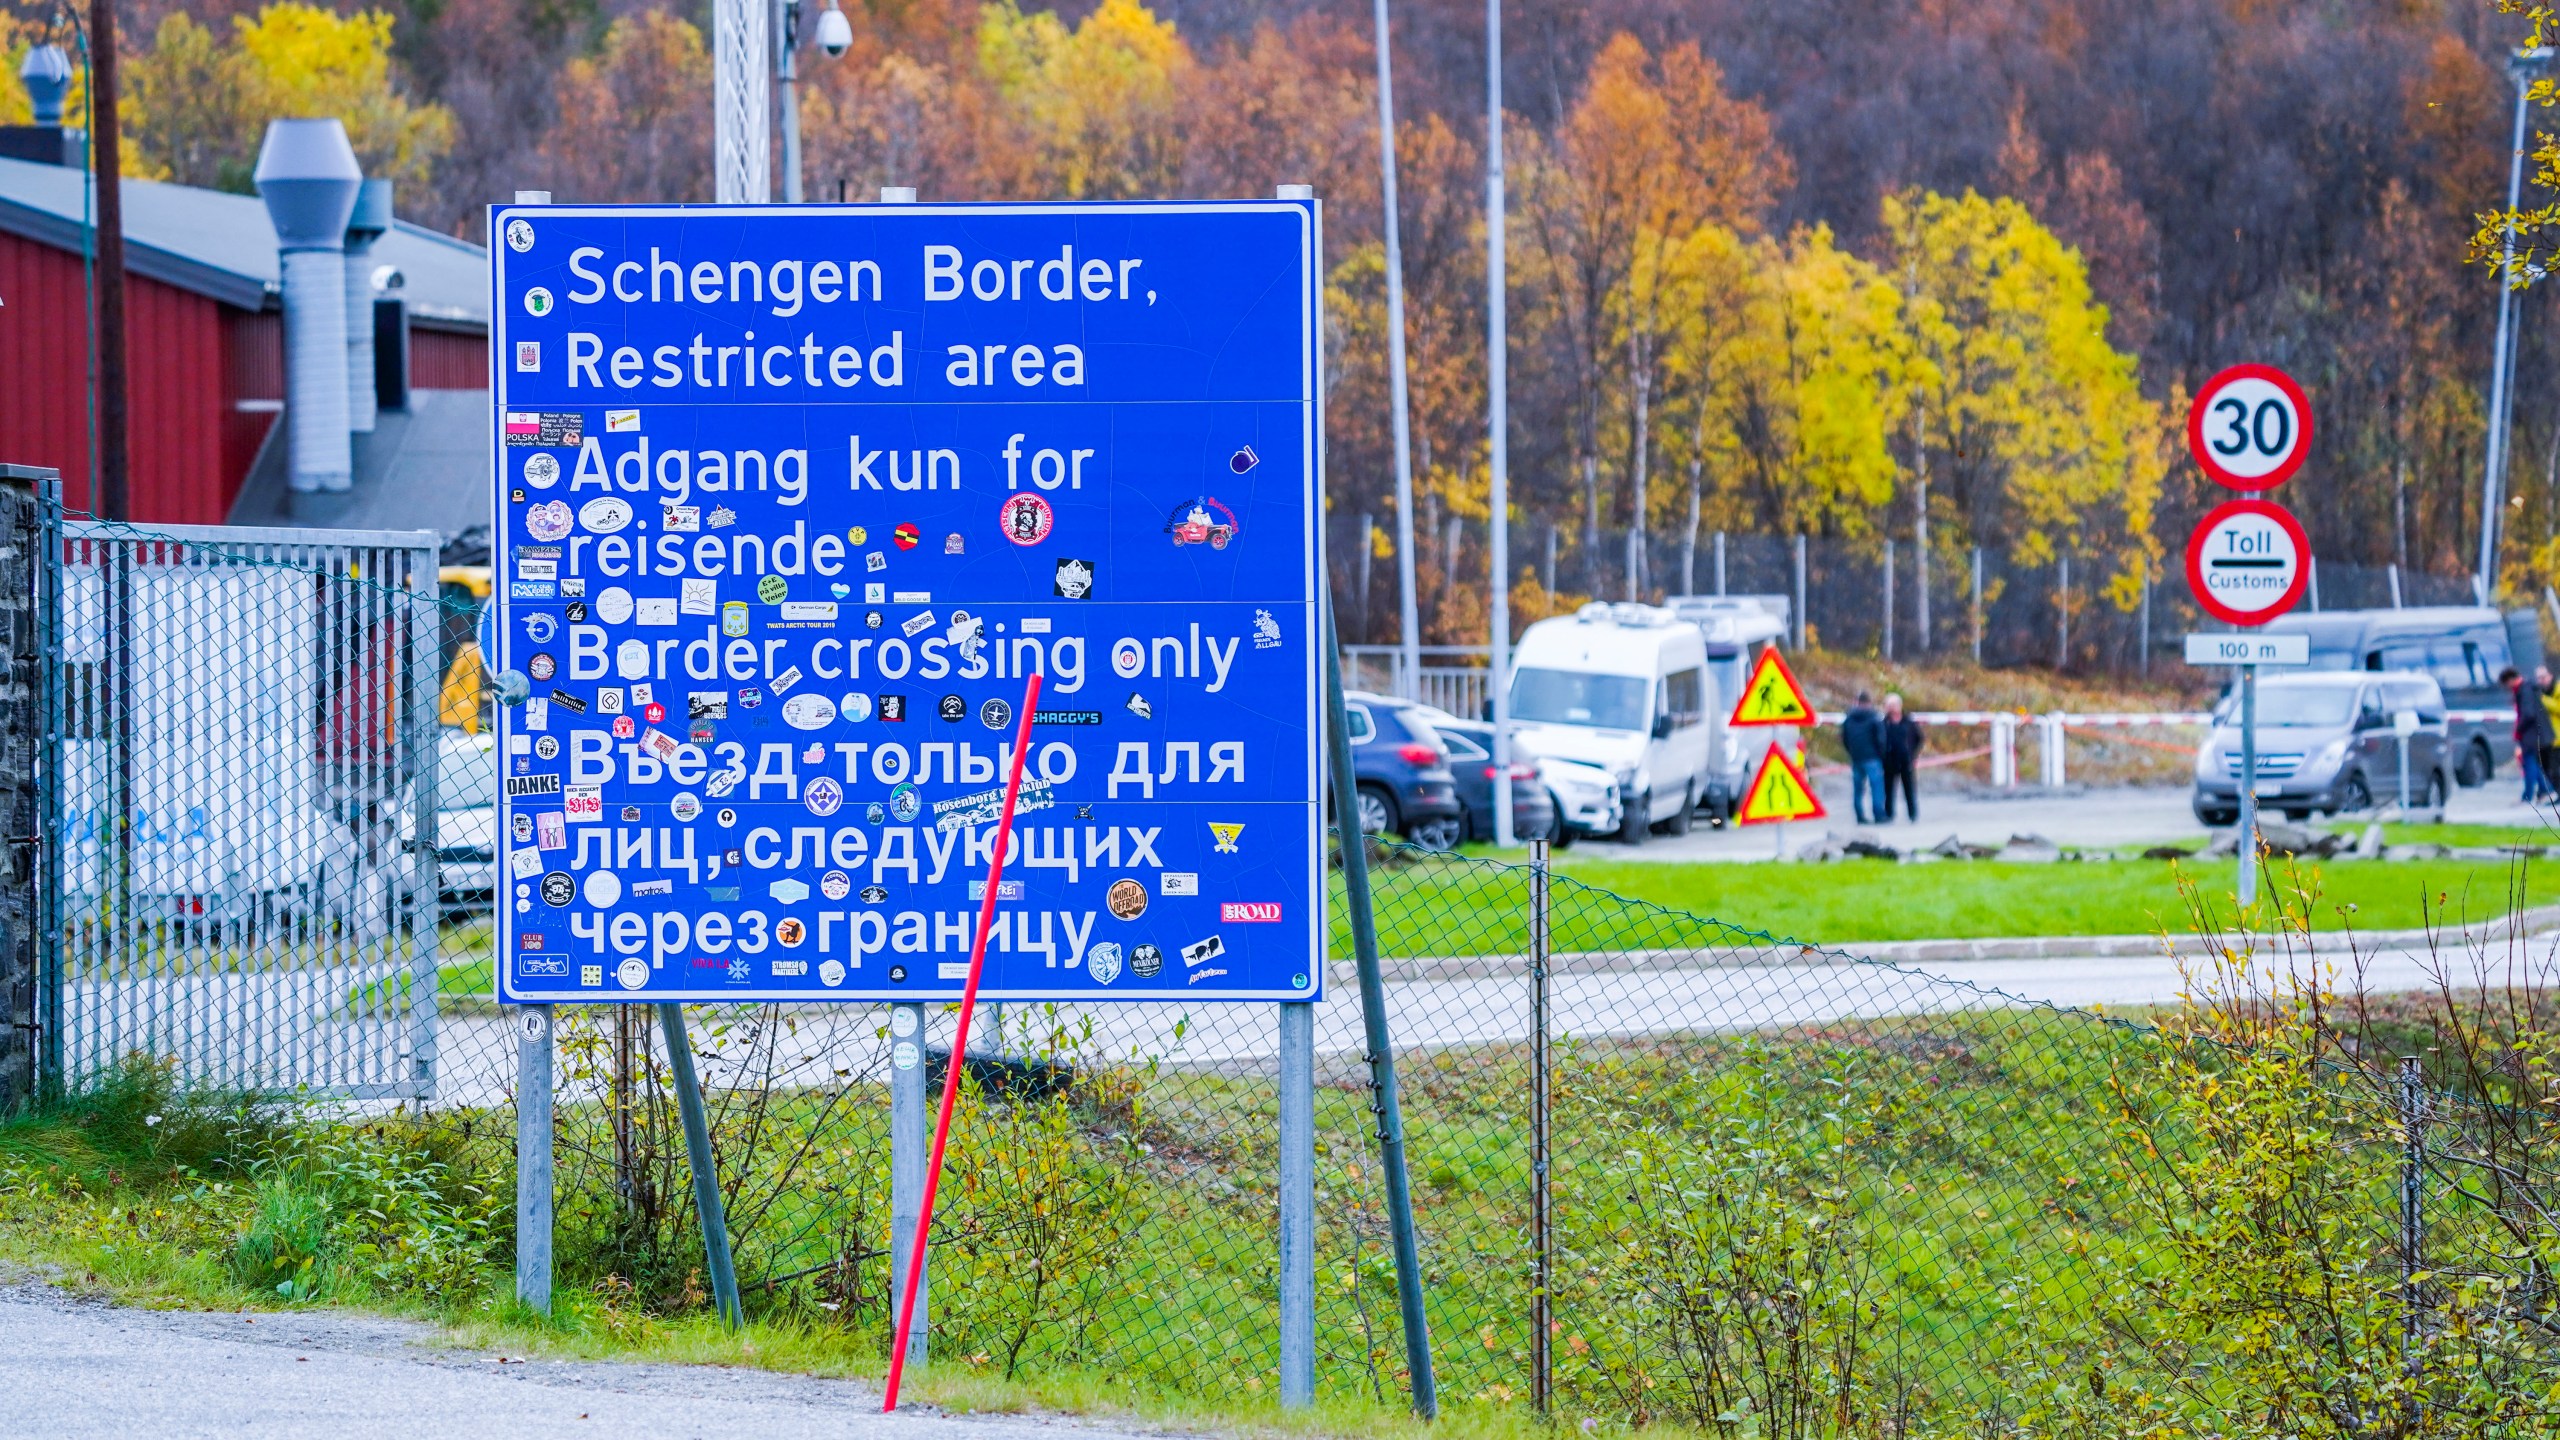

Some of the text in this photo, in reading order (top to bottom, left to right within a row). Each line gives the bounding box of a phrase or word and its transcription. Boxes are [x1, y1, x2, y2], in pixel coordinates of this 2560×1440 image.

[567, 244, 1157, 318] Schengen Border,
[567, 330, 1085, 389] Restricted area
[2212, 398, 2290, 456] 30
[570, 433, 1095, 506] Adgang kun for
[1164, 499, 1196, 534] Buurman
[1198, 496, 1206, 505] &
[570, 519, 845, 577] reisende
[2225, 530, 2272, 554] Toll
[762, 576, 777, 586] E+E
[2208, 572, 2288, 589] Customs
[569, 622, 1241, 694] Brder crossing only
[2219, 642, 2276, 658] 100 m
[1032, 712, 1099, 723] SHAGGY'S
[569, 730, 1245, 800] Въезд только для
[506, 774, 559, 796] DANKE
[933, 778, 1051, 814] Rosenborg Blklub
[570, 824, 1164, 885] лиц, следующих
[634, 886, 666, 897] matros.
[1112, 886, 1136, 902] WORLD
[1112, 893, 1144, 911] OFFROAD
[1225, 904, 1280, 920] OFF ROAD
[523, 941, 542, 950] 100
[571, 910, 1097, 969] через границу
